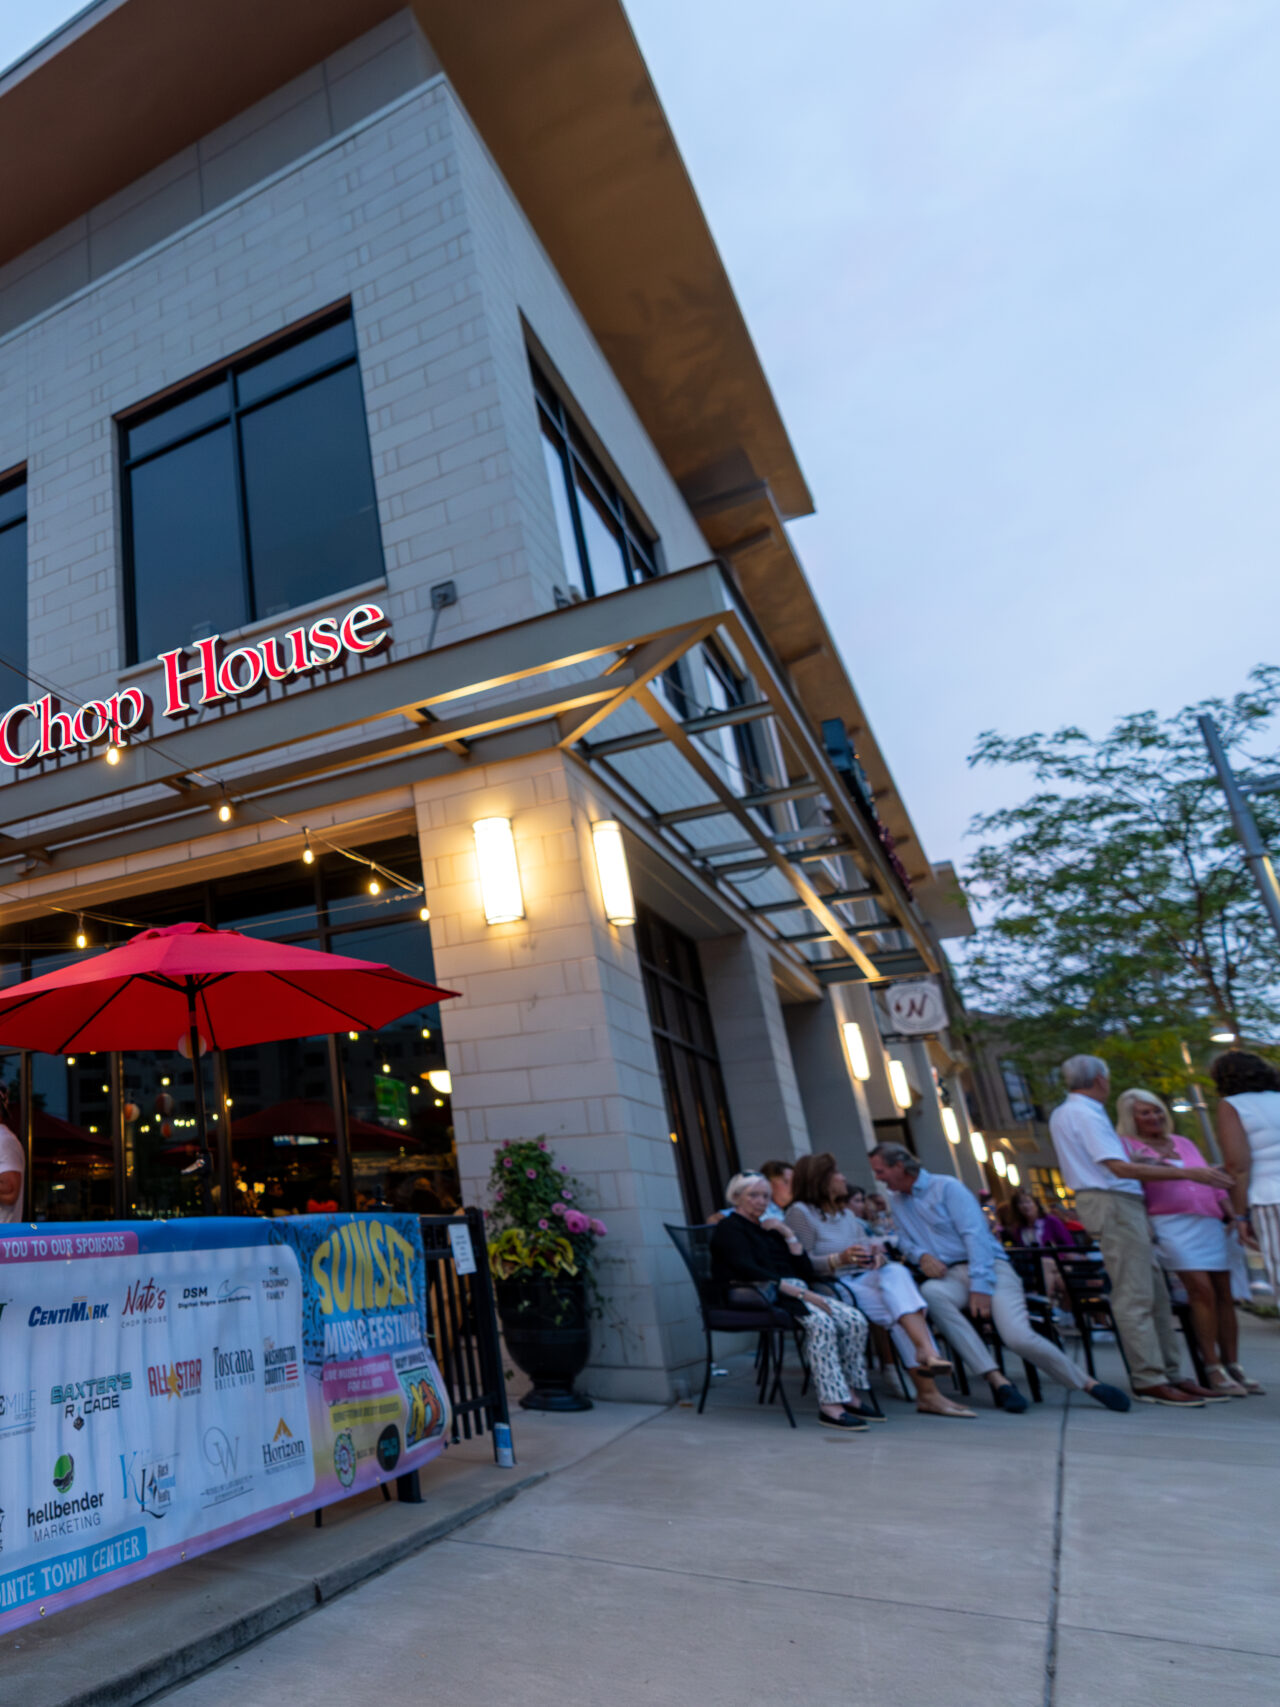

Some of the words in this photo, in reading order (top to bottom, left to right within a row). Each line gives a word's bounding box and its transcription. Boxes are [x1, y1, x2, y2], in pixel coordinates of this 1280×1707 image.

[158, 603, 387, 717] House
[3, 1240, 27, 1258] YOU
[31, 1239, 48, 1257] TO
[51, 1238, 73, 1255] OUR
[76, 1236, 125, 1254] SPONSORS
[312, 1220, 415, 1315] SUNSET
[122, 1277, 167, 1315] Nate's
[183, 1286, 208, 1299] DSM
[324, 1319, 368, 1355] MUSIC
[148, 1364, 171, 1398] ALL
[176, 1358, 202, 1391] STAR
[213, 1346, 255, 1379] Toscana
[50, 1371, 133, 1405] BAXTER'S
[261, 1438, 306, 1466] Horizon
[27, 1491, 104, 1528] hellbender
[34, 1511, 101, 1543] MARKETING
[40, 1555, 87, 1591] TOWN
[91, 1536, 140, 1573] CENTER
